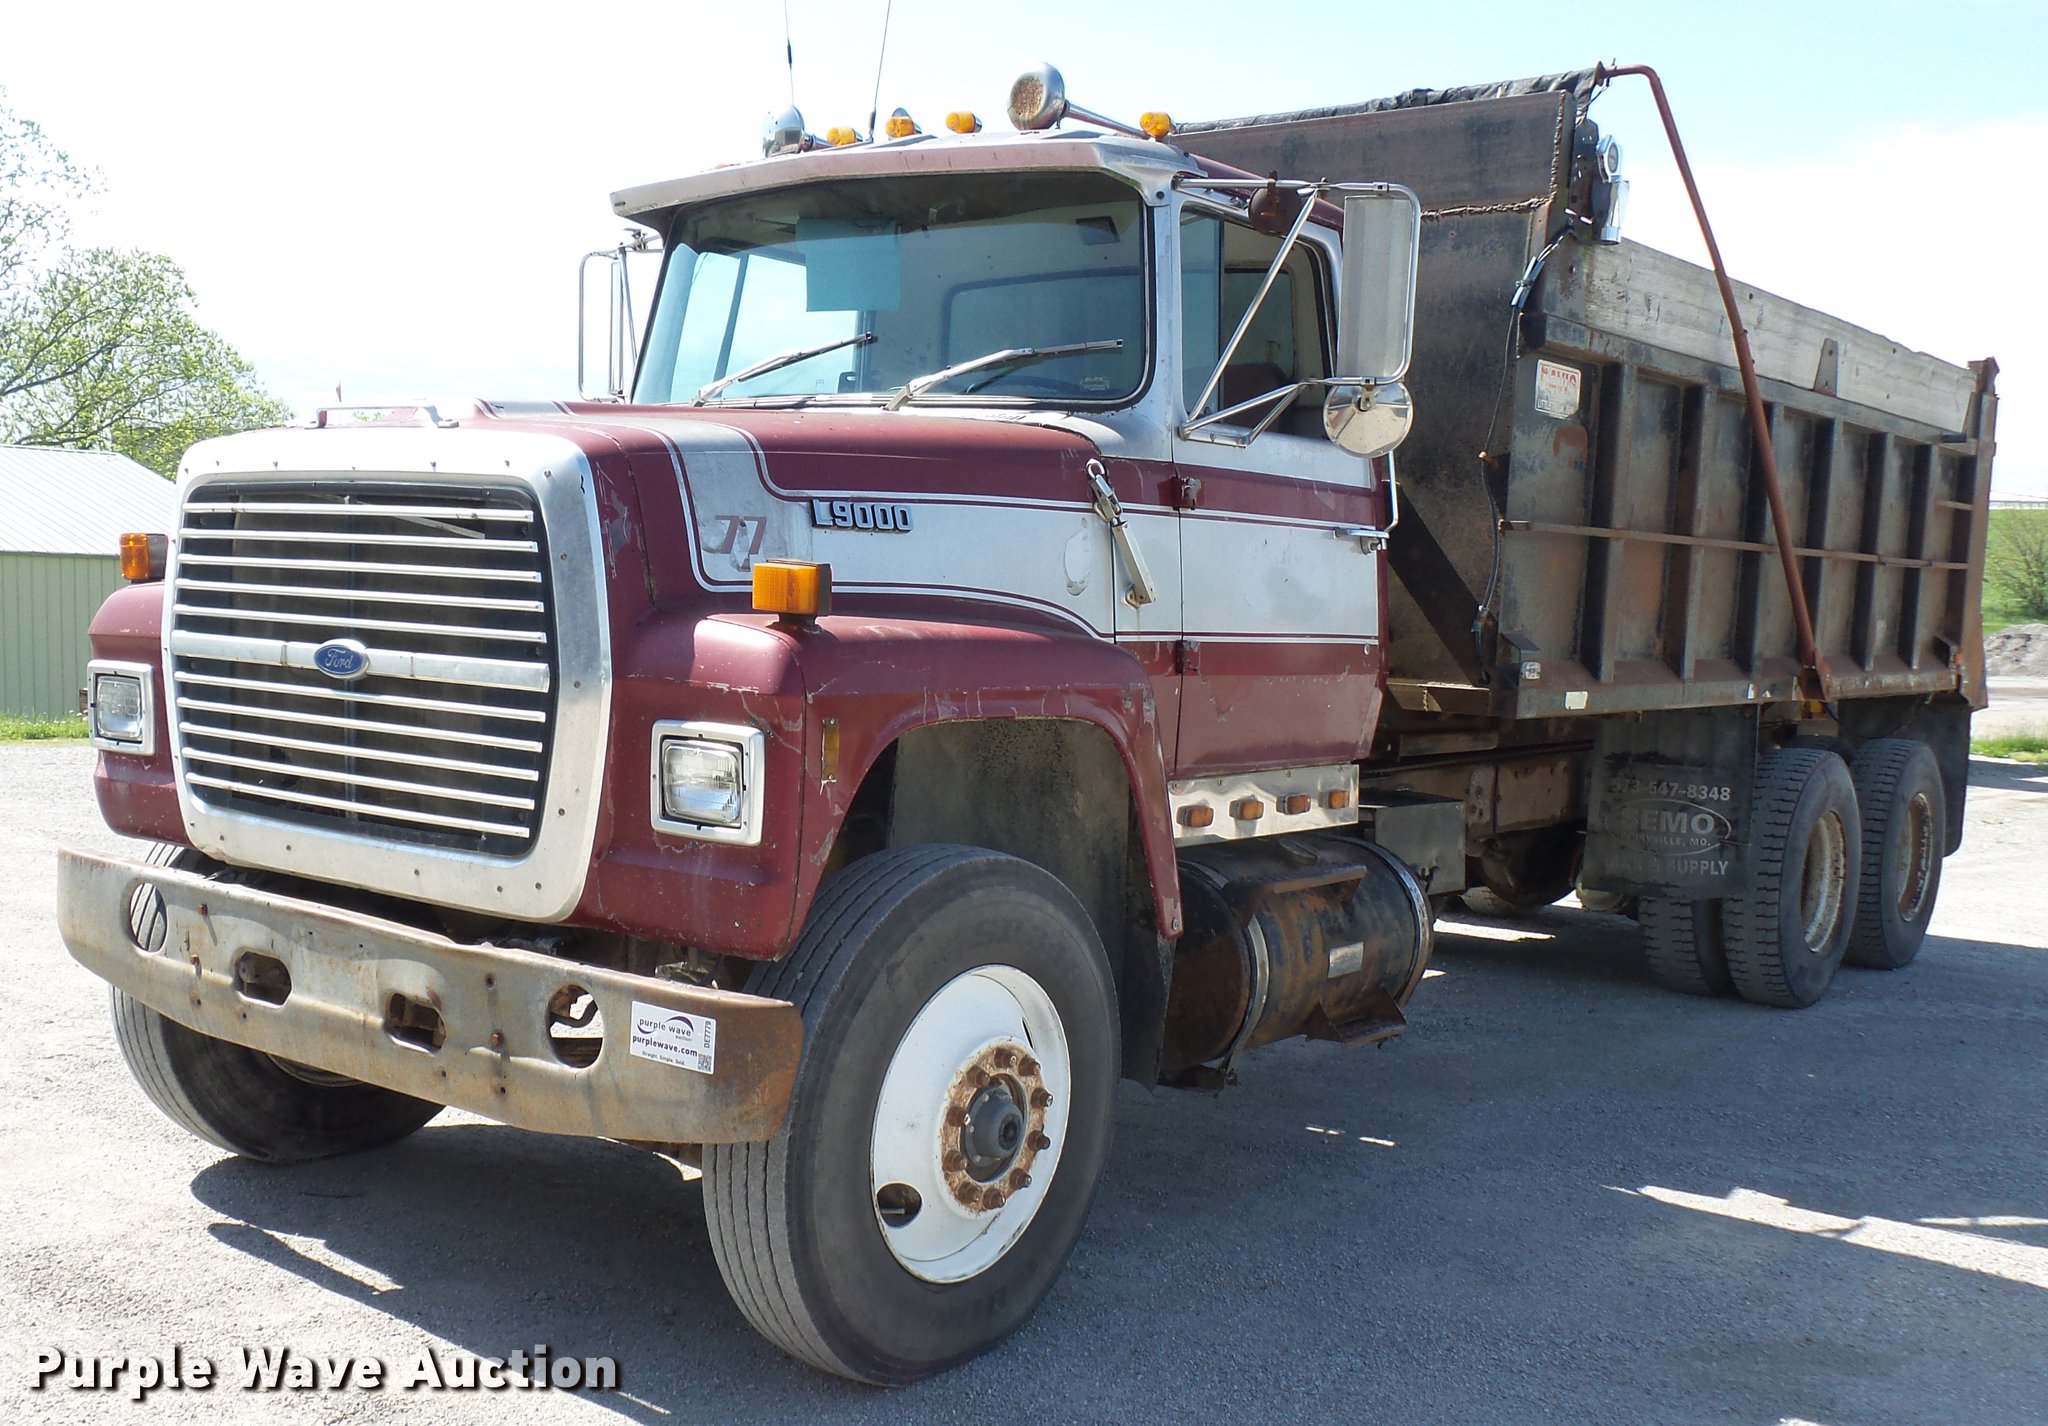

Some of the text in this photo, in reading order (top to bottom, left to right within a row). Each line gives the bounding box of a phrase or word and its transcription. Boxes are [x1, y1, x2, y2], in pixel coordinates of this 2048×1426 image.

[811, 497, 914, 533] L9000
[714, 515, 767, 555] 77
[325, 648, 353, 669] Ford
[639, 1018, 691, 1036] purple wave
[703, 1020, 712, 1049] DE7779
[632, 1035, 698, 1057] purplewave.com
